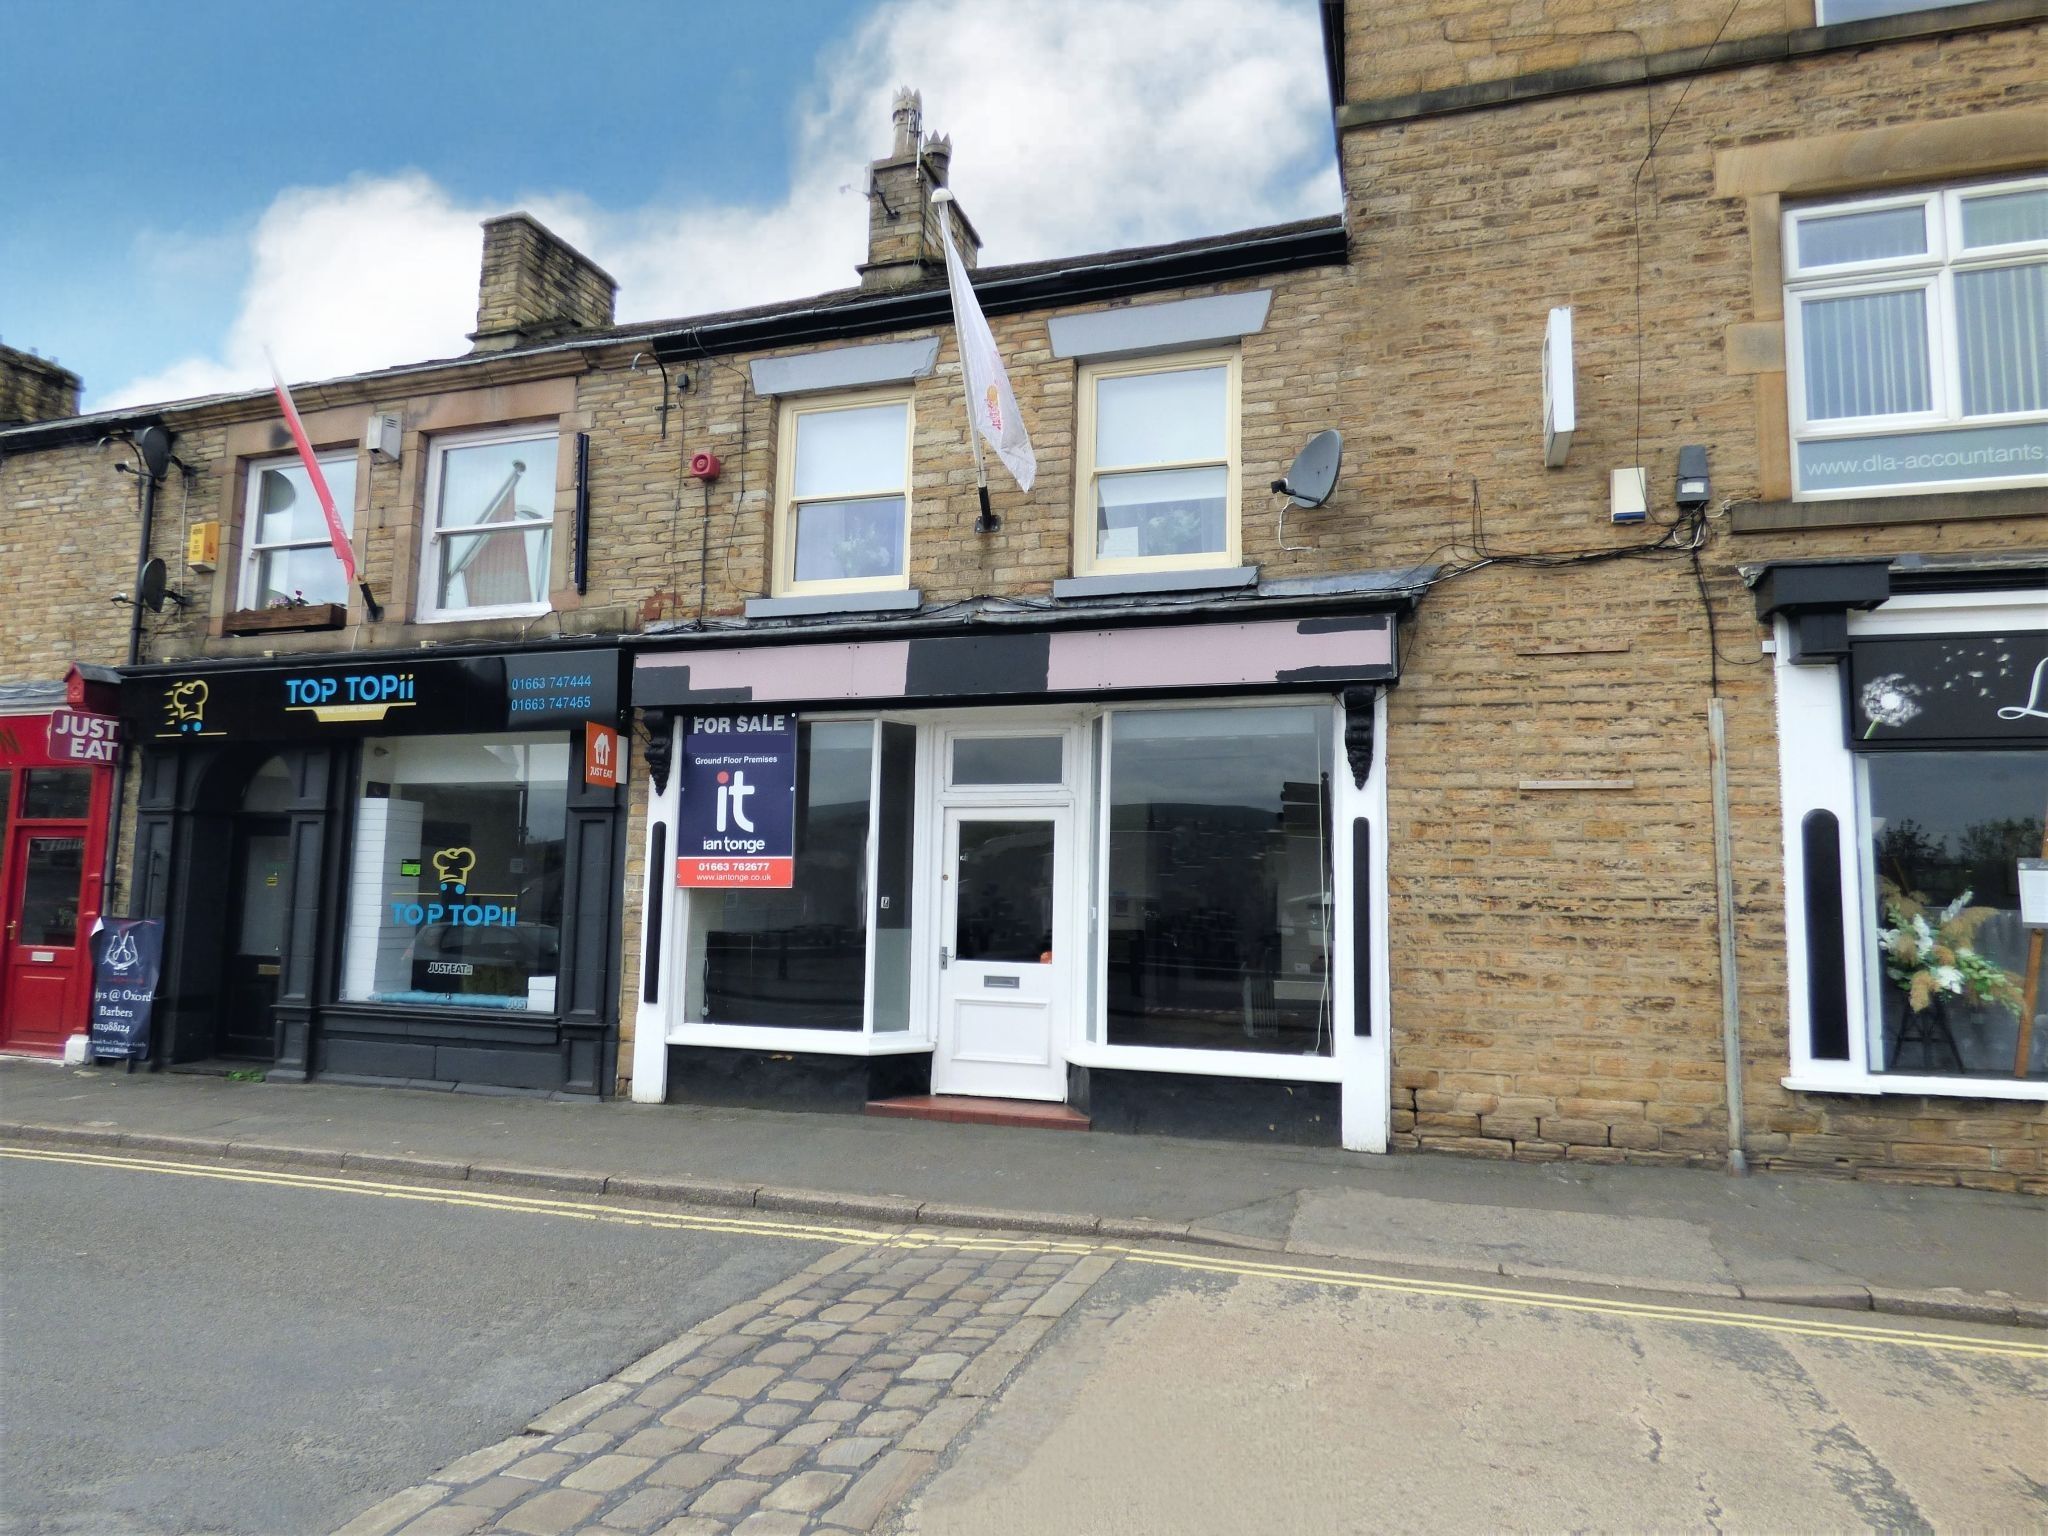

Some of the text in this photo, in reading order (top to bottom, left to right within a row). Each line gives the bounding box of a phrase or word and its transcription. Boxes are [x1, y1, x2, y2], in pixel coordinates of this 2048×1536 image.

[511, 675, 592, 690] 01663 747444
[286, 679, 337, 704] TOP
[511, 696, 591, 711] 01663 747455
[55, 715, 119, 740] JUST
[693, 715, 785, 734] FOR SALE
[70, 737, 118, 760] EAT
[695, 755, 778, 765] Ground Floor Premises
[590, 766, 613, 779] JUST EAT
[716, 770, 755, 833] it
[703, 836, 765, 853] ian tonge
[698, 862, 770, 871] 01663 762677
[696, 874, 771, 882] www.iantonge.co.uk
[391, 903, 444, 926] TOP
[428, 962, 466, 974] JUST EAT
[99, 1006, 133, 1017] Barbers
